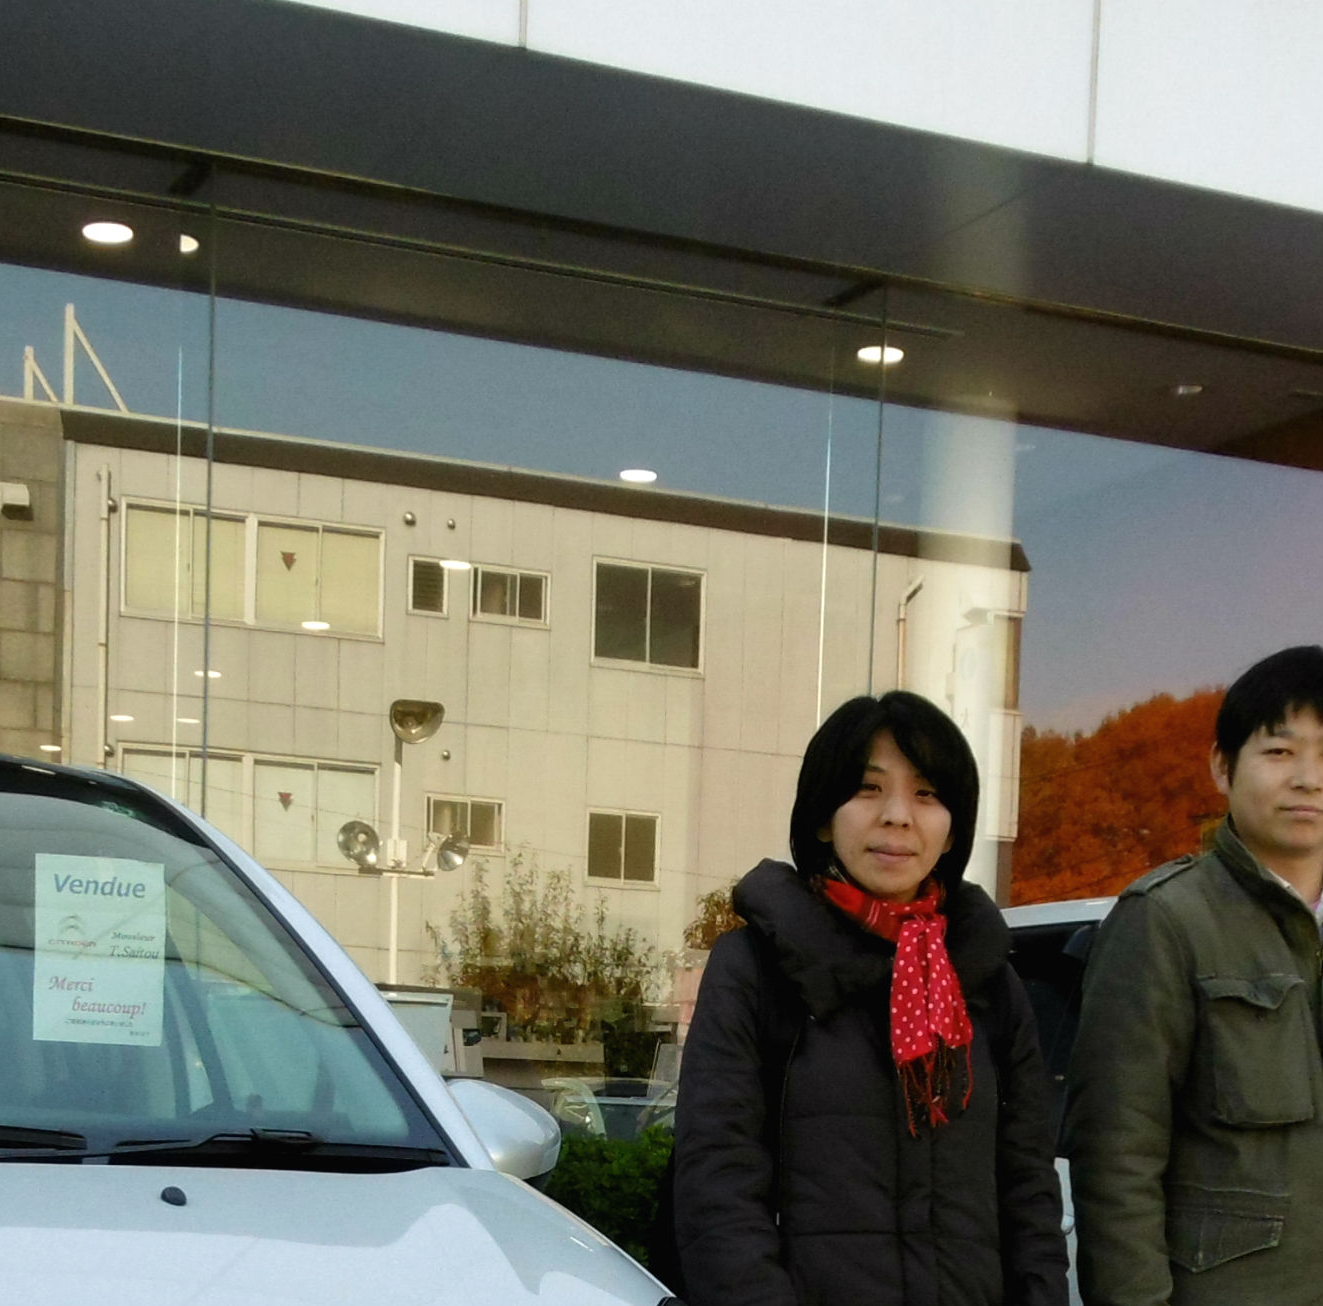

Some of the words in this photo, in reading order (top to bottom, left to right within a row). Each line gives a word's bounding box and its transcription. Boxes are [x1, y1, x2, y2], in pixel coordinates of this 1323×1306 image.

[54, 873, 146, 899] Vendue
[48, 976, 95, 993] Merci
[72, 995, 147, 1019] beaucoup!
